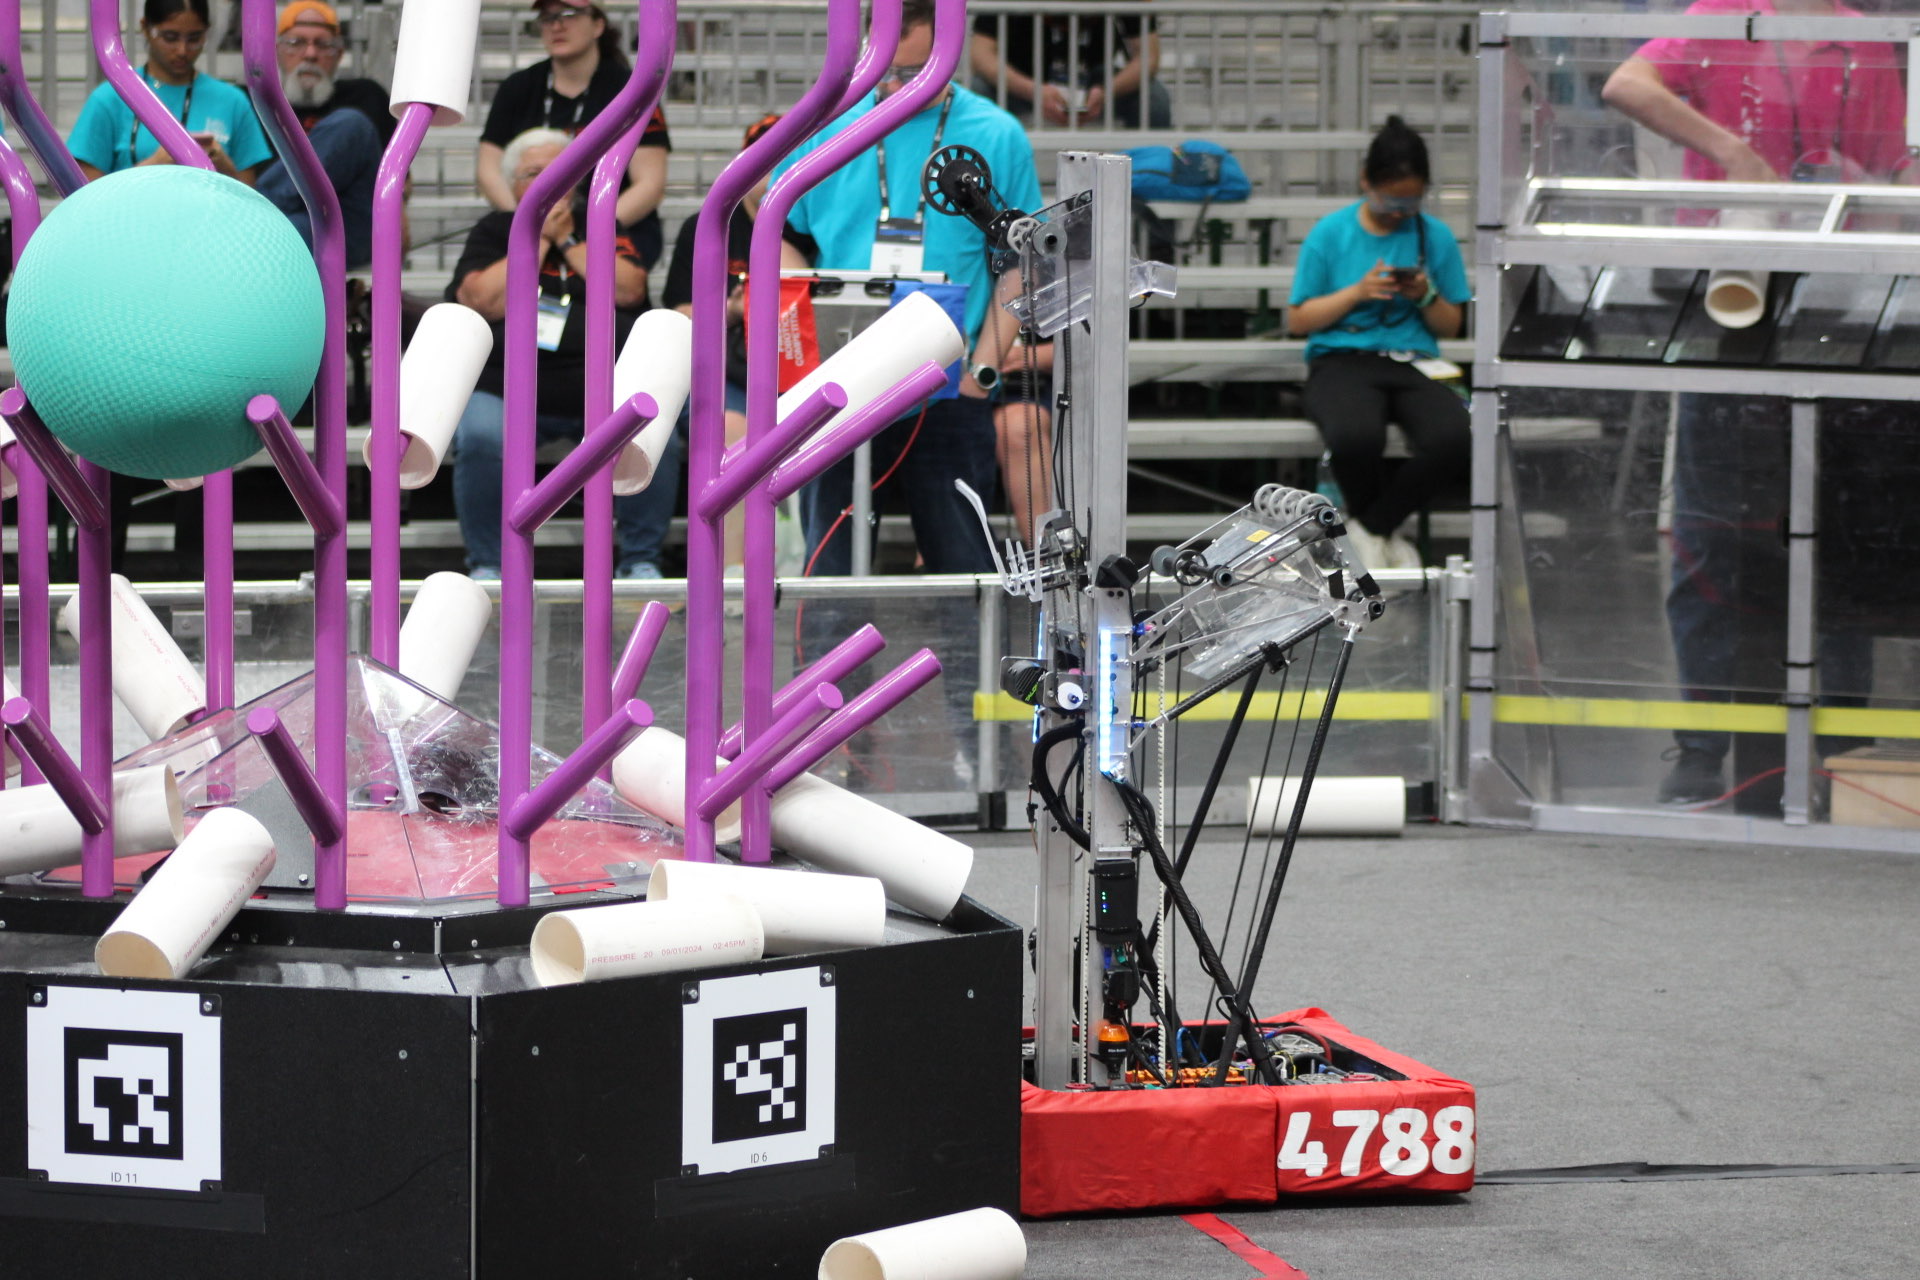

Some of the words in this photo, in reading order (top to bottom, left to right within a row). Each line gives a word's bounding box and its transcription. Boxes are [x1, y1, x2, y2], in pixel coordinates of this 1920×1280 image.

[591, 952, 638, 964] PRESSURE
[643, 950, 654, 959] 20
[661, 945, 703, 956] 09/01/2024
[712, 939, 746, 951] 02:45PM
[1277, 1105, 1475, 1177] 4788
[750, 1153, 760, 1163] ID
[761, 1151, 768, 1162] 6
[110, 1172, 122, 1183] ID
[125, 1172, 137, 1184] 11
